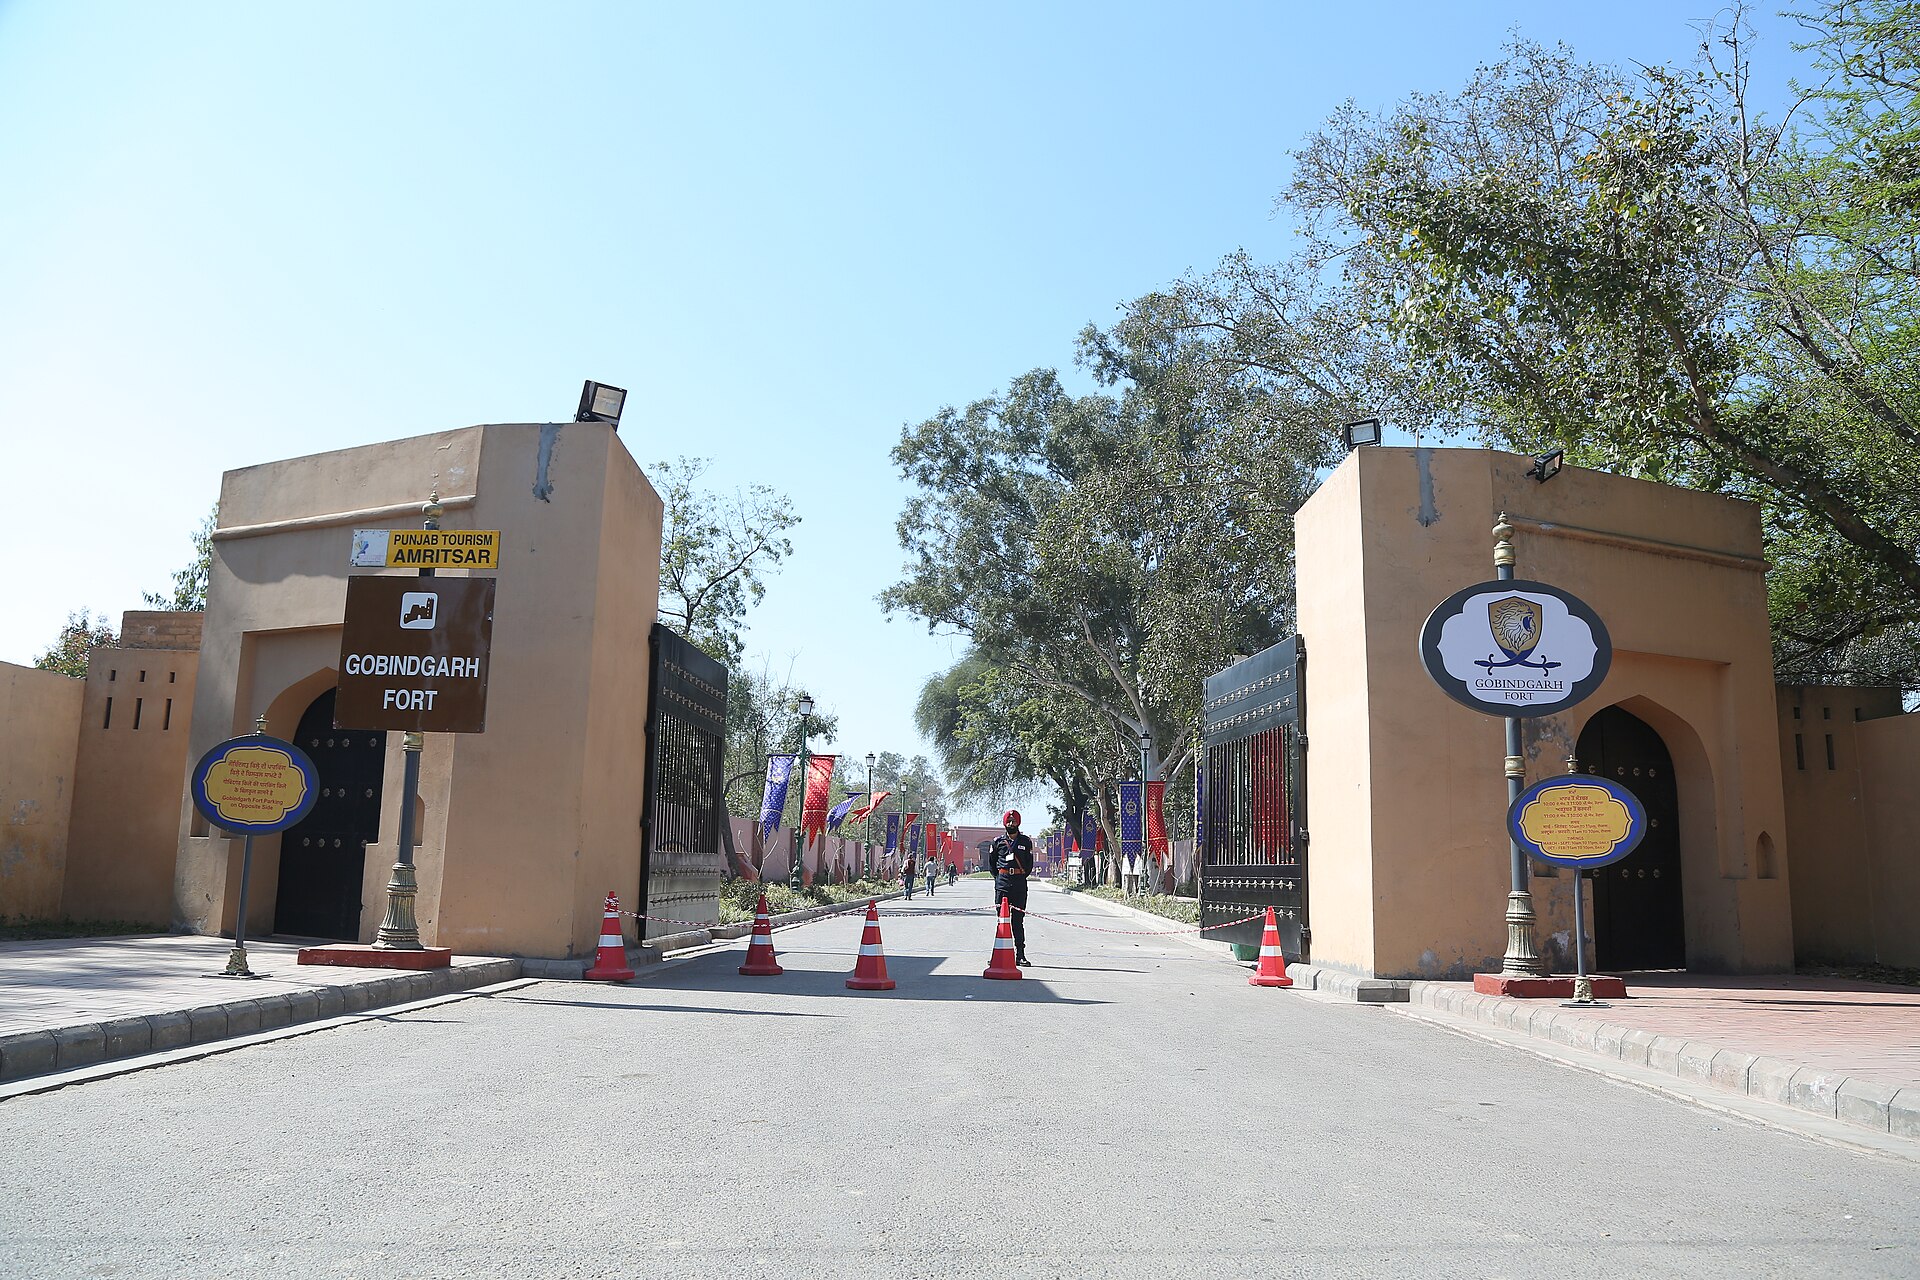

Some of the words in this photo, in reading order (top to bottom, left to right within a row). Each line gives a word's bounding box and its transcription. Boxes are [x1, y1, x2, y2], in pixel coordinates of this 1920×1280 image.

[394, 534, 438, 545] PUNJAB
[442, 534, 492, 546] TOURISM
[393, 549, 490, 564] AMRITSAR
[345, 654, 480, 677] GOBINDGARH
[1475, 679, 1563, 689] GOBINDGARH
[383, 689, 438, 710] FORT
[1505, 692, 1534, 700] FORT
